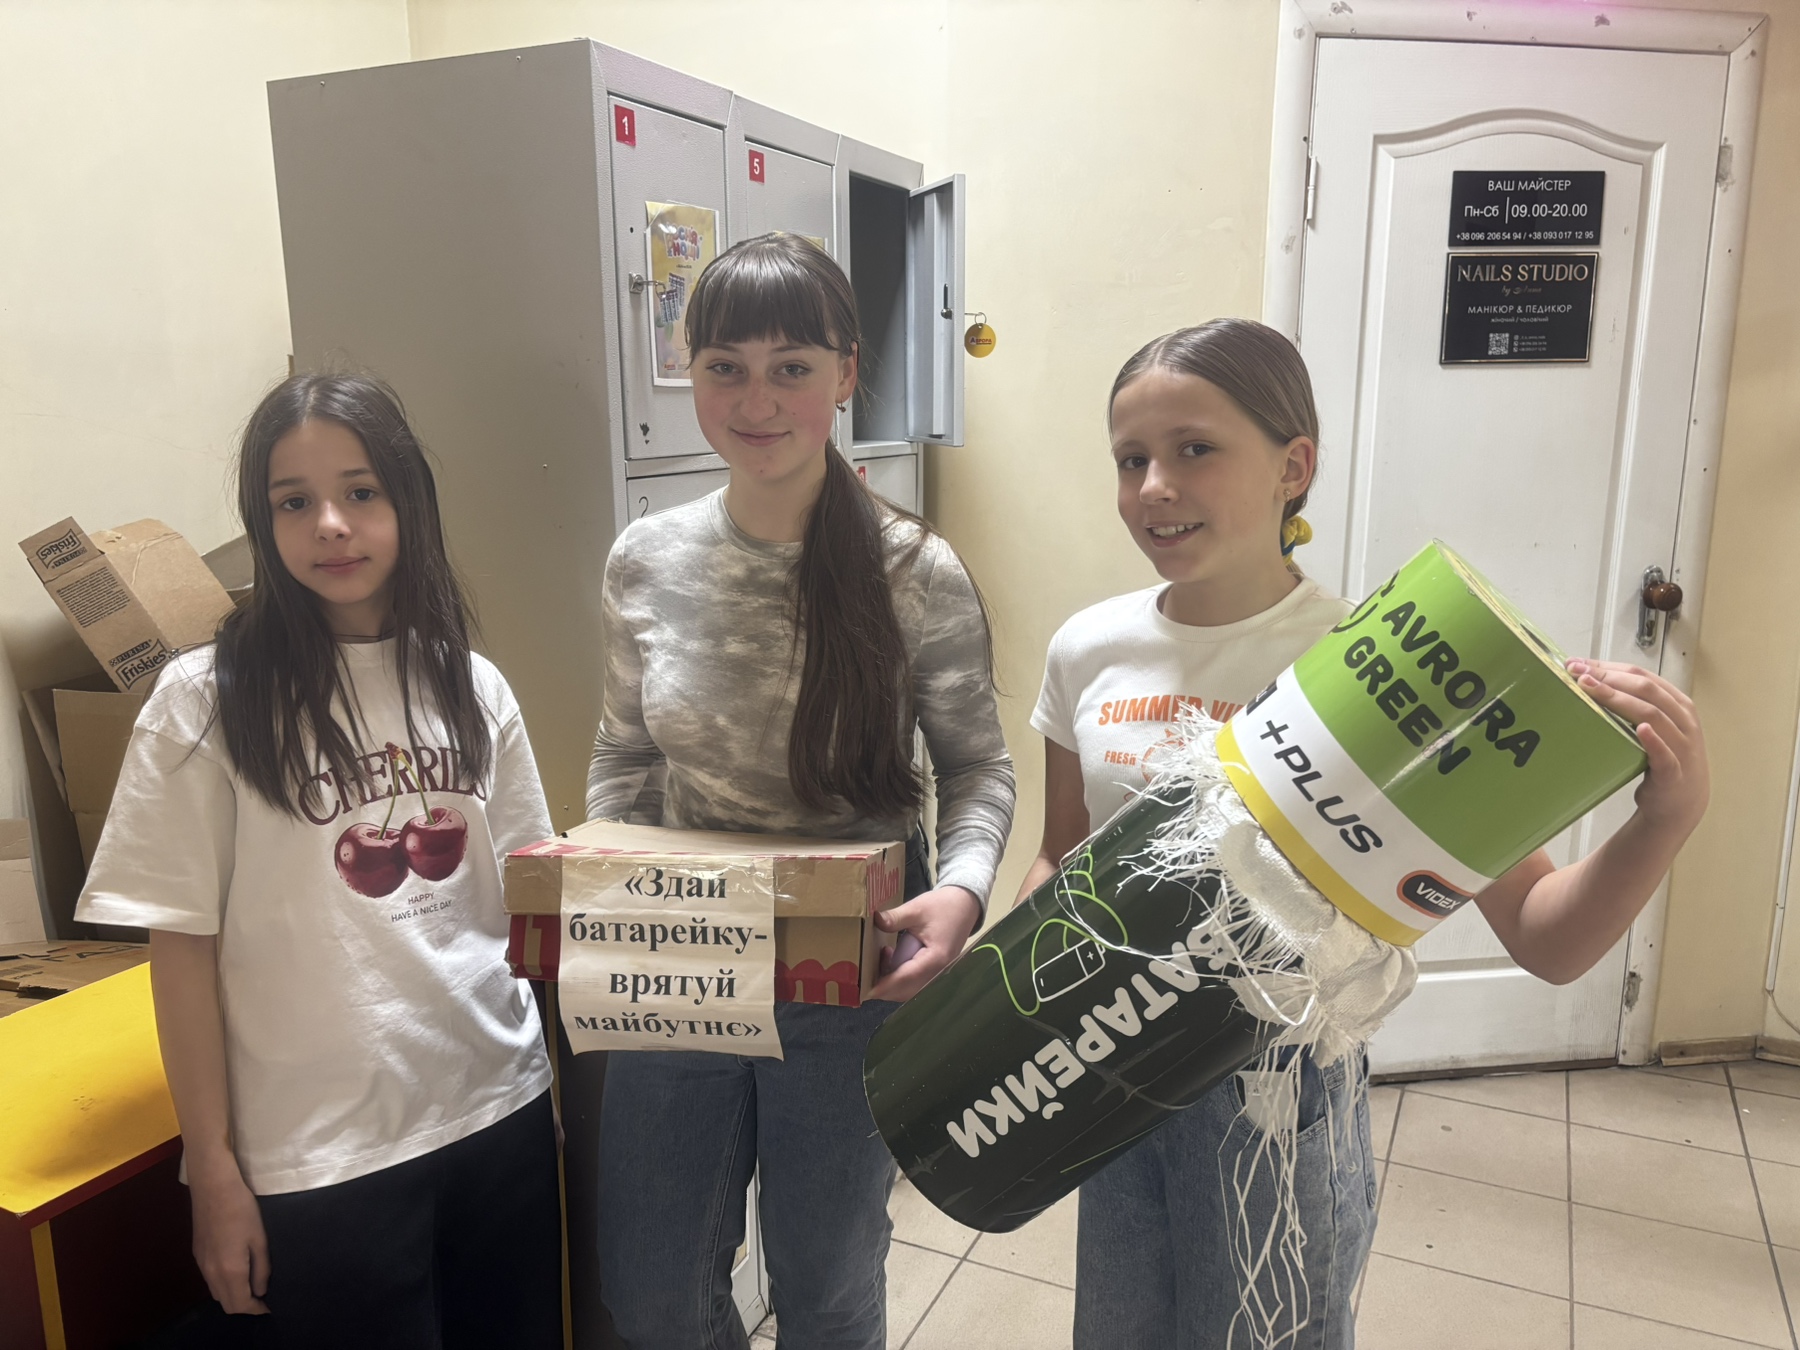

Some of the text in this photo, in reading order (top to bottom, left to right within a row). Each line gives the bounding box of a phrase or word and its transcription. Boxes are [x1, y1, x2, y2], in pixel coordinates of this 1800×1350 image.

[621, 115, 629, 136] 1
[753, 158, 760, 175] 5
[1487, 177, 1572, 192] ВАШ МАЙСТЕР
[1464, 203, 1588, 218] Пн-Сб 09.00-20.00
[1471, 232, 1485, 240] 096
[1512, 232, 1522, 240] 94
[1575, 231, 1583, 239] 12
[1584, 231, 1594, 239] 95
[1457, 263, 1589, 282] NAILS STUDIO
[1467, 304, 1573, 314] МАНІКЮР & ПЕДИКЮР
[40, 534, 78, 560] Friskies
[120, 648, 167, 682] Friskies
[1381, 600, 1541, 768] AVRORA
[1343, 635, 1472, 776] GREEN
[407, 892, 435, 905] HAPPY
[1416, 881, 1461, 910] VIDEX
[391, 899, 452, 923] HAVE A NICE DAY
[569, 912, 768, 955] батарейку-
[608, 968, 737, 1006] врятуй
[573, 1011, 762, 1039] майбутнє»
